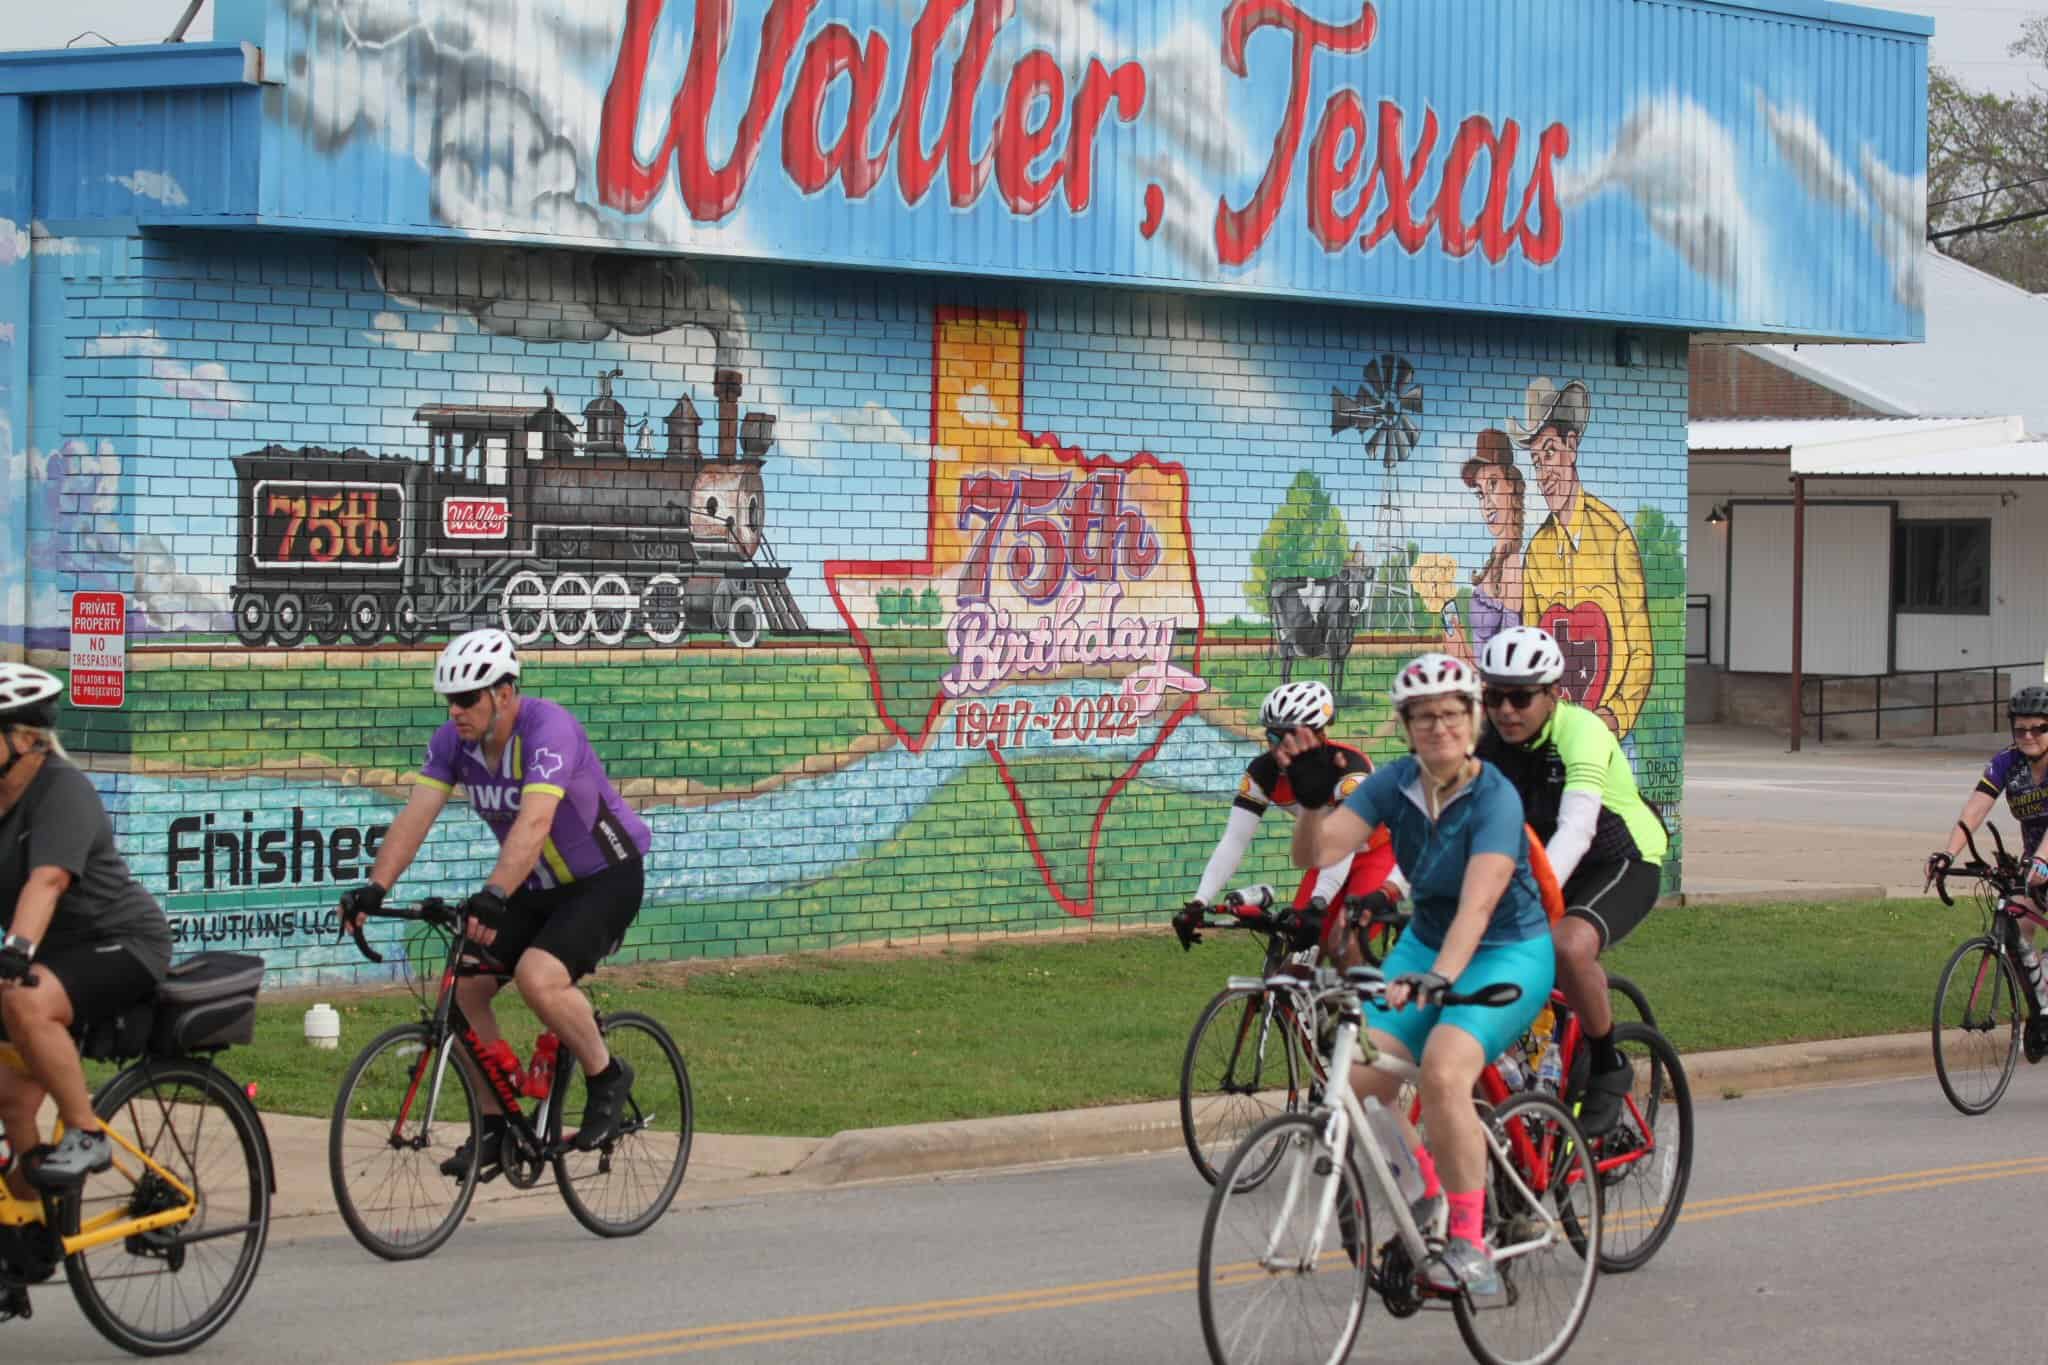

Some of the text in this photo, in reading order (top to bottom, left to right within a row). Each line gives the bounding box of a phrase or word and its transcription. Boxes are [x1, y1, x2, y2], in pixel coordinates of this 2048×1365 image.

[1215, 0, 1570, 266] Texas
[267, 491, 398, 562] 75th
[448, 505, 512, 530] Waller
[956, 468, 1161, 607] 75th
[80, 602, 117, 615] PRIVATE
[74, 617, 121, 631] PROPERTY
[89, 638, 105, 651] NO
[940, 581, 1209, 717] Birthday
[73, 654, 122, 667] TRESPASSING
[73, 675, 121, 685] VIOLATORS WILL
[73, 686, 121, 697] BE PROSECUTED
[302, 910, 338, 935] LLC
